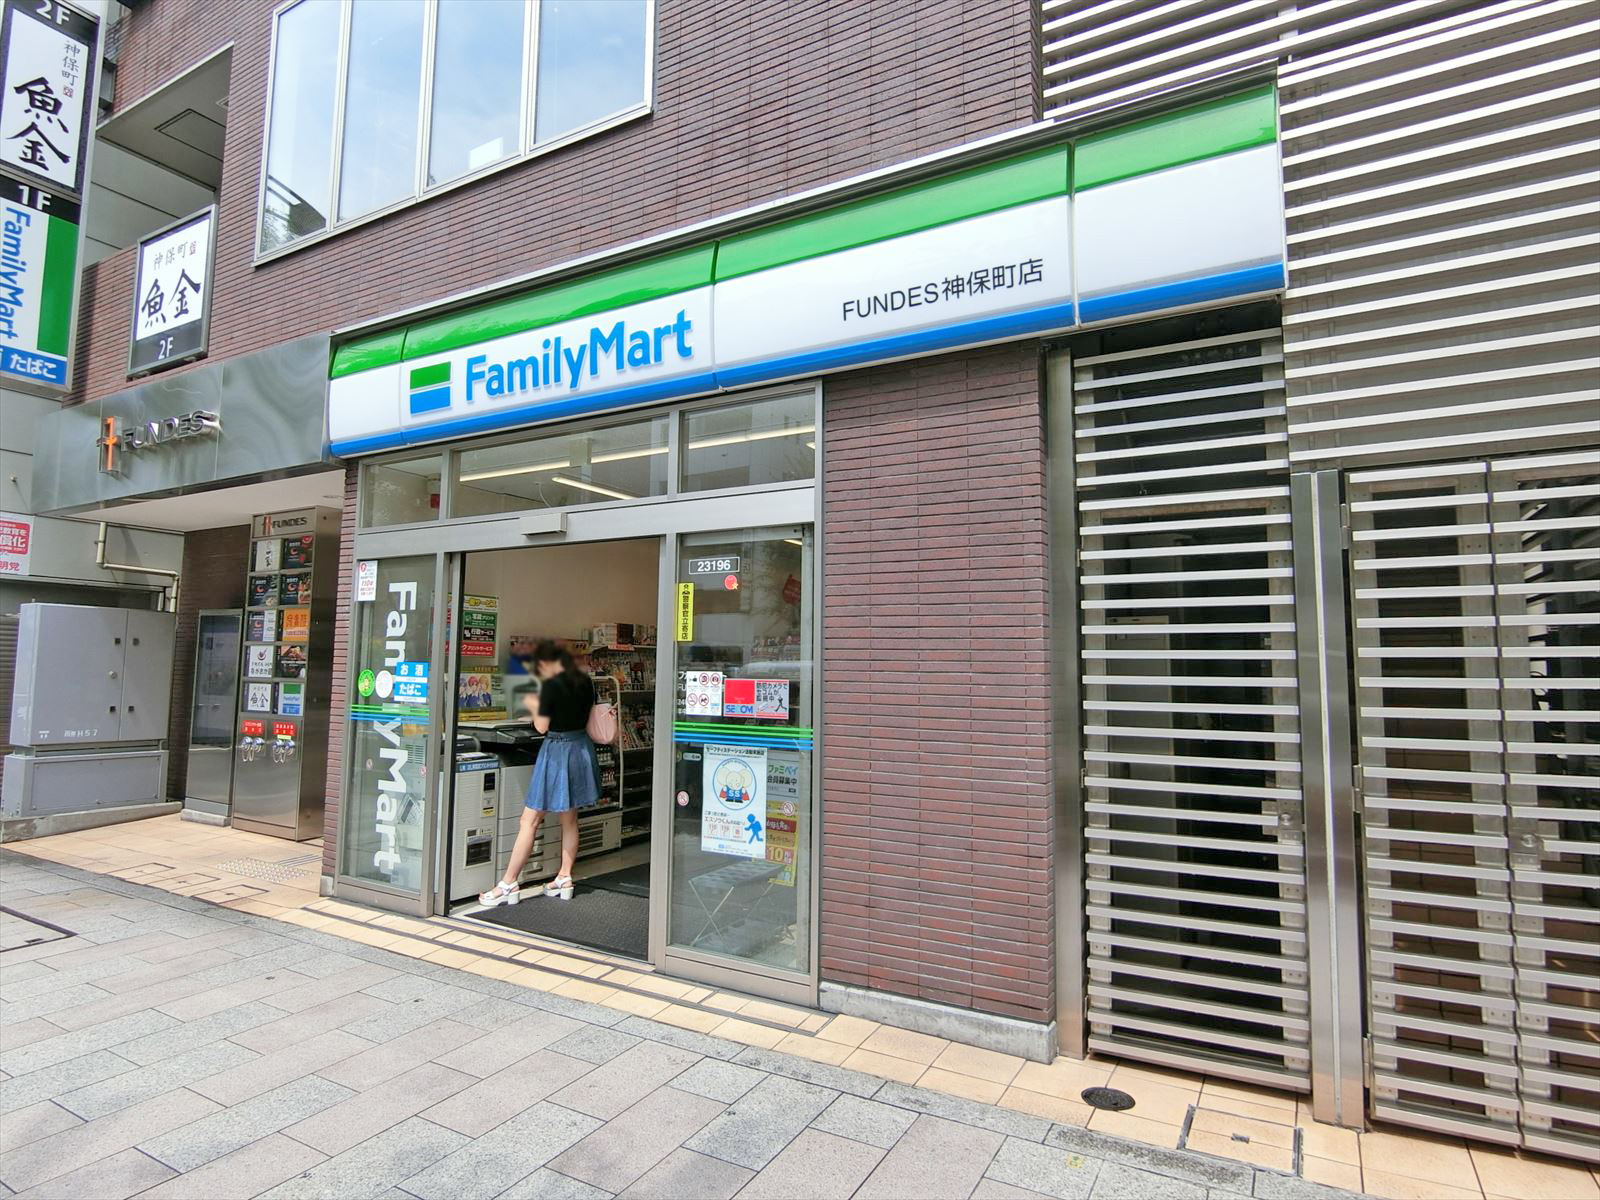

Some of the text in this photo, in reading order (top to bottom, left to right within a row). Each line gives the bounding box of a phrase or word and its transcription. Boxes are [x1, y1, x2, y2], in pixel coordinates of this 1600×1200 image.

[36, 0, 70, 24] 2F
[62, 41, 80, 86] 神保町
[6, 77, 71, 170] 魚金
[18, 185, 52, 211] 1F
[154, 241, 188, 271] 神保町
[0, 207, 31, 340] FamilyMart
[141, 269, 201, 328] 魚金
[158, 337, 174, 360] 2F
[466, 308, 693, 402] FamilyMart
[10, 353, 57, 379] たばこ
[121, 409, 212, 452] FUNDES
[697, 560, 731, 572] 23196
[399, 683, 422, 696] たばこ
[725, 705, 753, 714] SEOM
